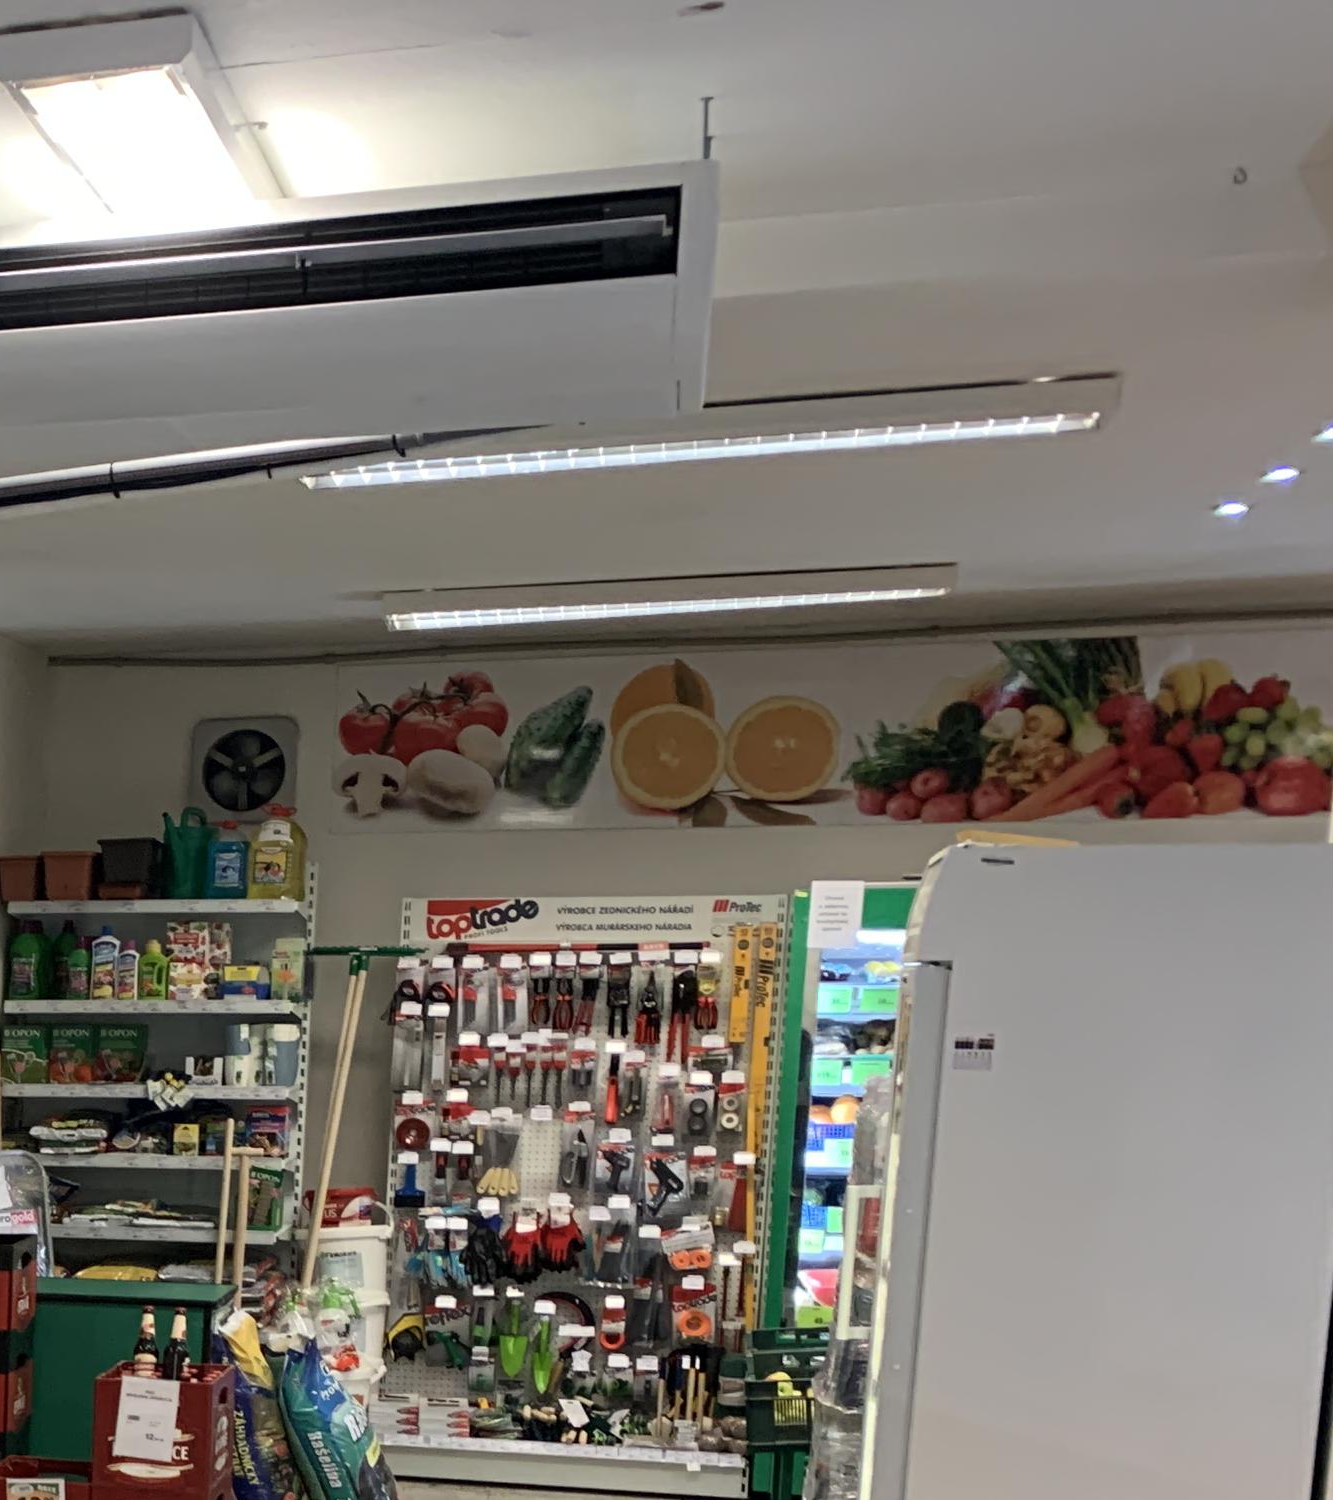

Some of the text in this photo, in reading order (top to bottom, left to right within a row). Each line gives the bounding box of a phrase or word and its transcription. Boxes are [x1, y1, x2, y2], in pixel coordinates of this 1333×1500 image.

[556, 904, 596, 915] VÝROBCE
[659, 903, 694, 915] NÁŘADÍ
[729, 900, 762, 913] ProTec
[426, 899, 539, 940] toptrade
